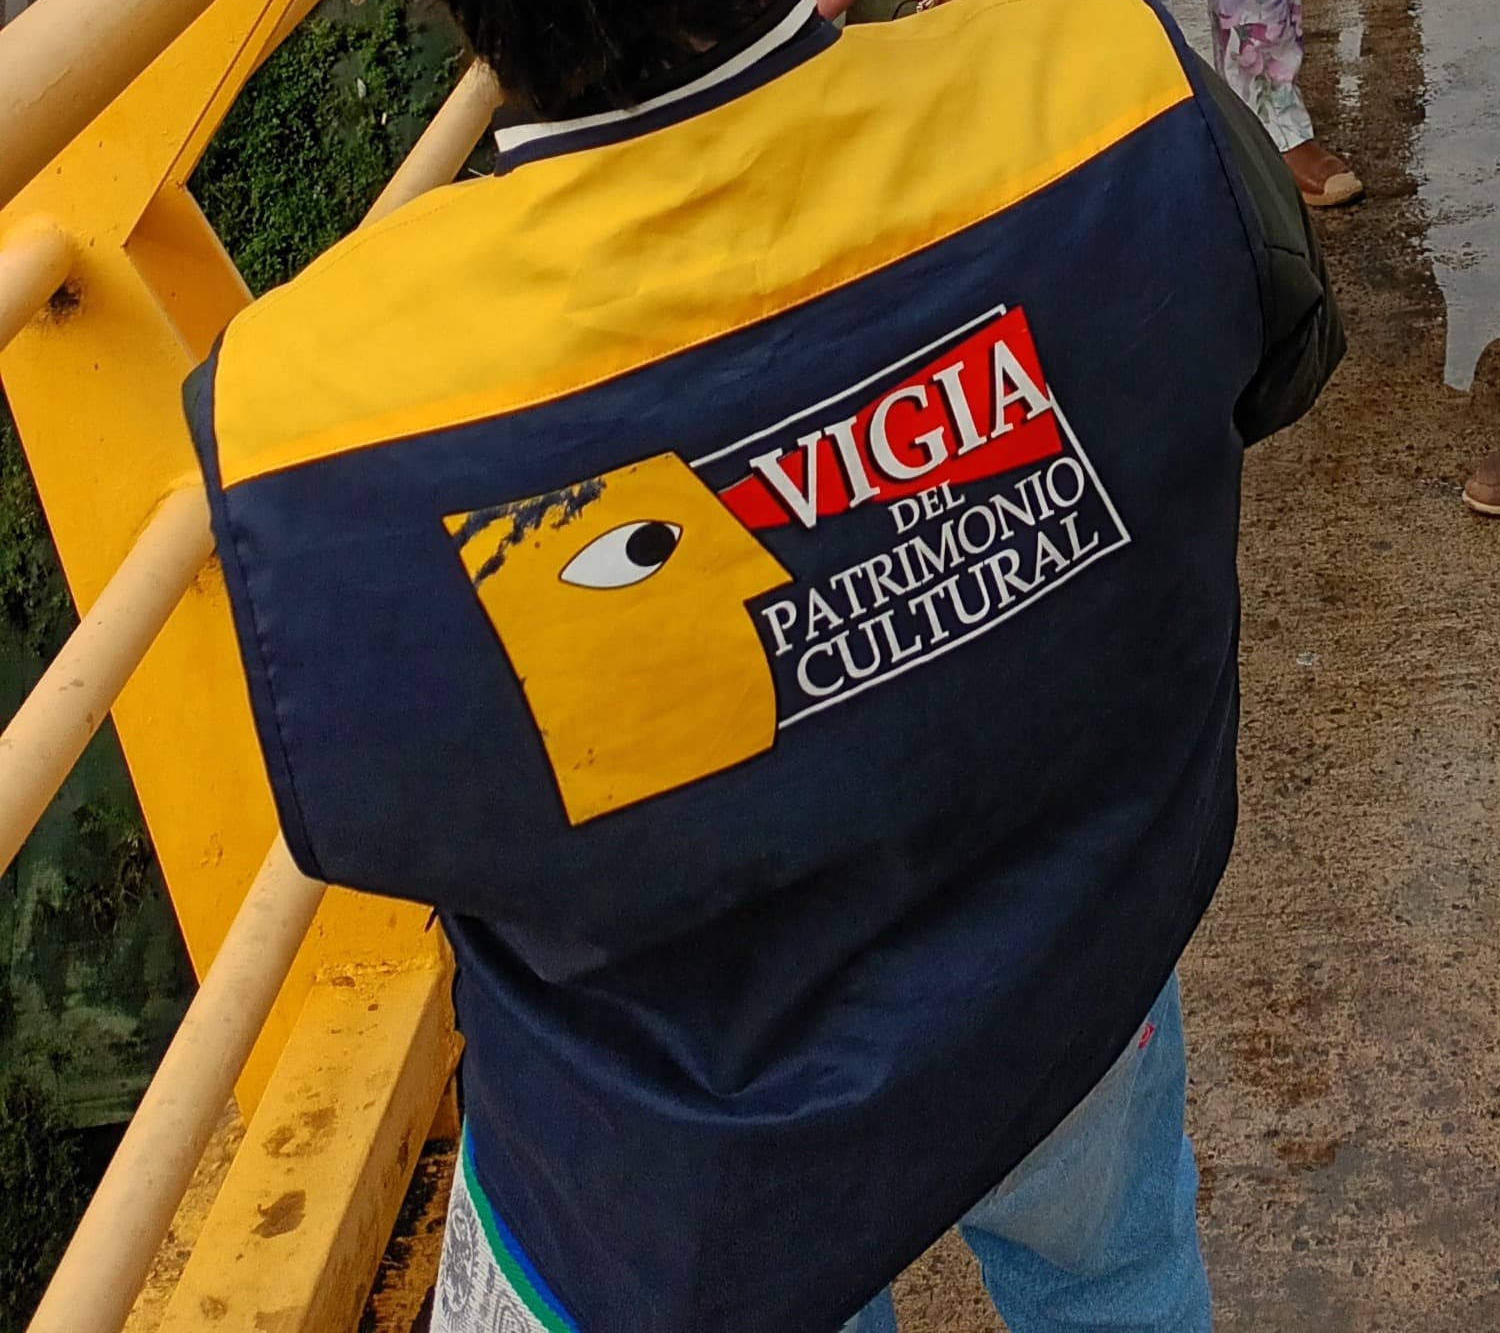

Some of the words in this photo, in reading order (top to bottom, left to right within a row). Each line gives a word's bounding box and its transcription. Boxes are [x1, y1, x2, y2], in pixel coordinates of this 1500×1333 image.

[749, 339, 1053, 530] VIGIA
[888, 479, 966, 534] DEL
[761, 456, 1086, 657] PATRIMONIO
[796, 511, 1099, 697] CULTURAL
